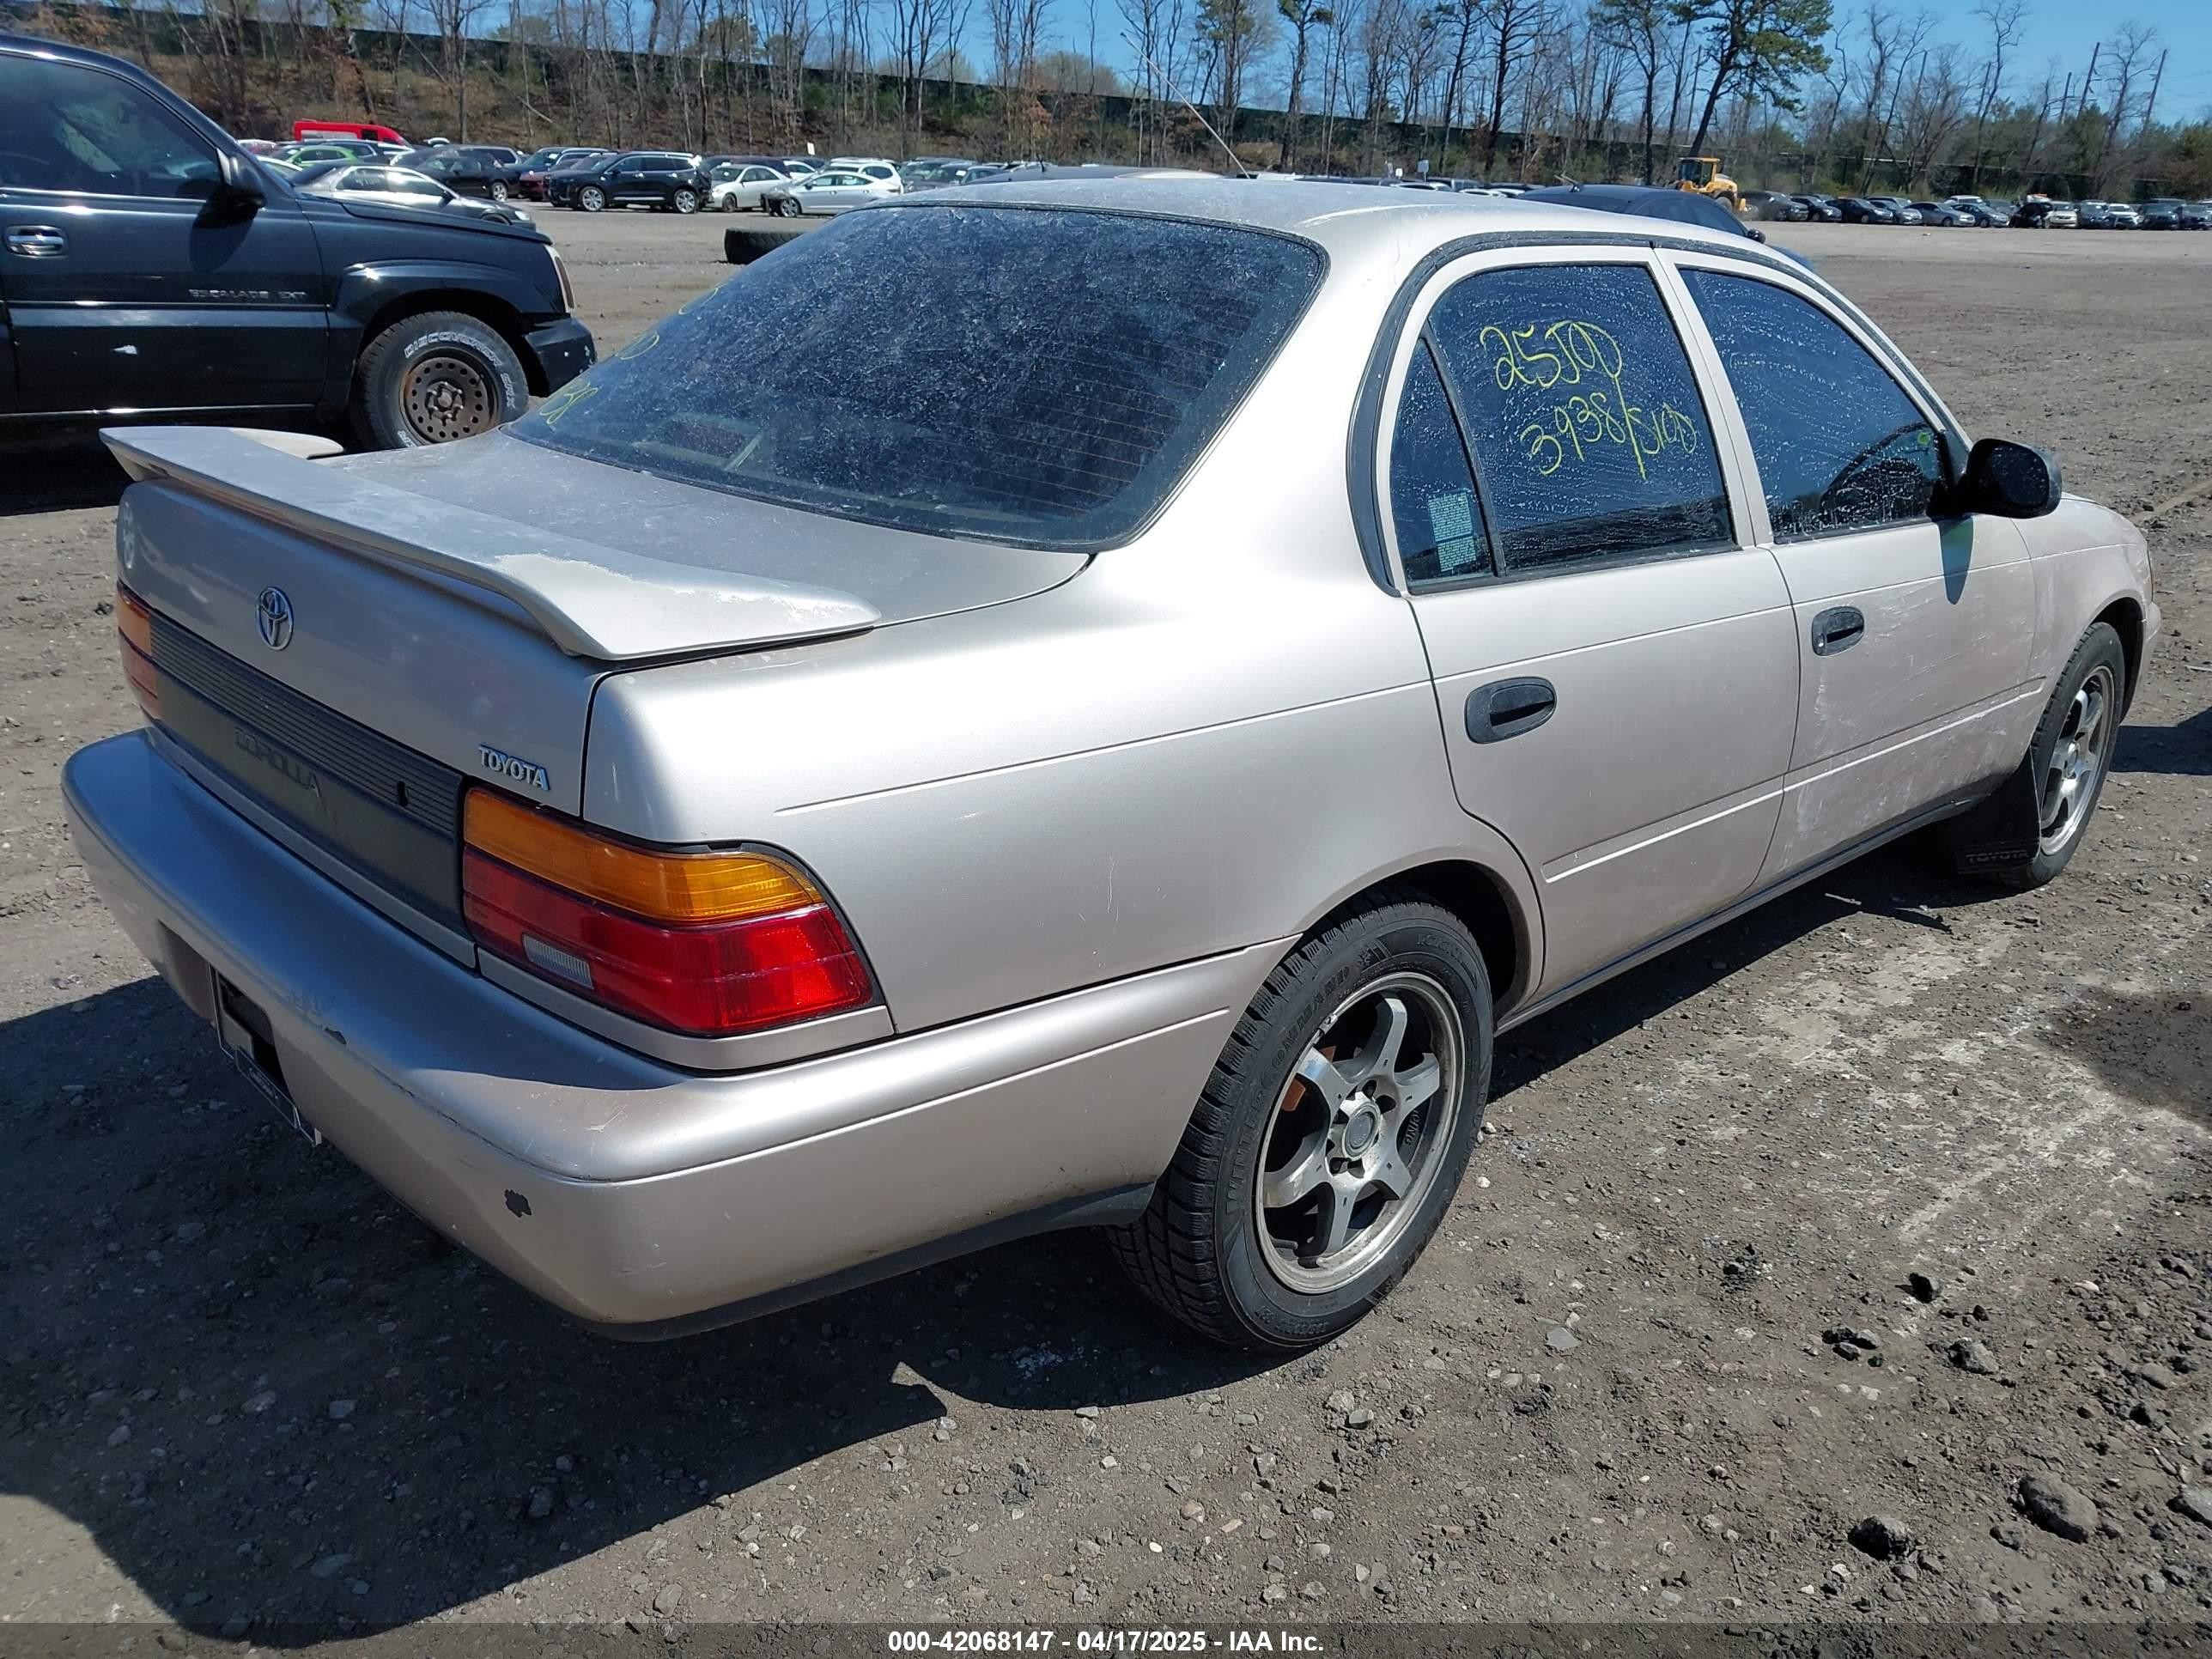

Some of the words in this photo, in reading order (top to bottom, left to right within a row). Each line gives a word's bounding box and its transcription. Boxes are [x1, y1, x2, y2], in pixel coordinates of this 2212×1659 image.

[189, 289, 269, 300] ESCALADE
[477, 742, 550, 792] TOYOTA
[1260, 965, 1350, 1085] COMMAND
